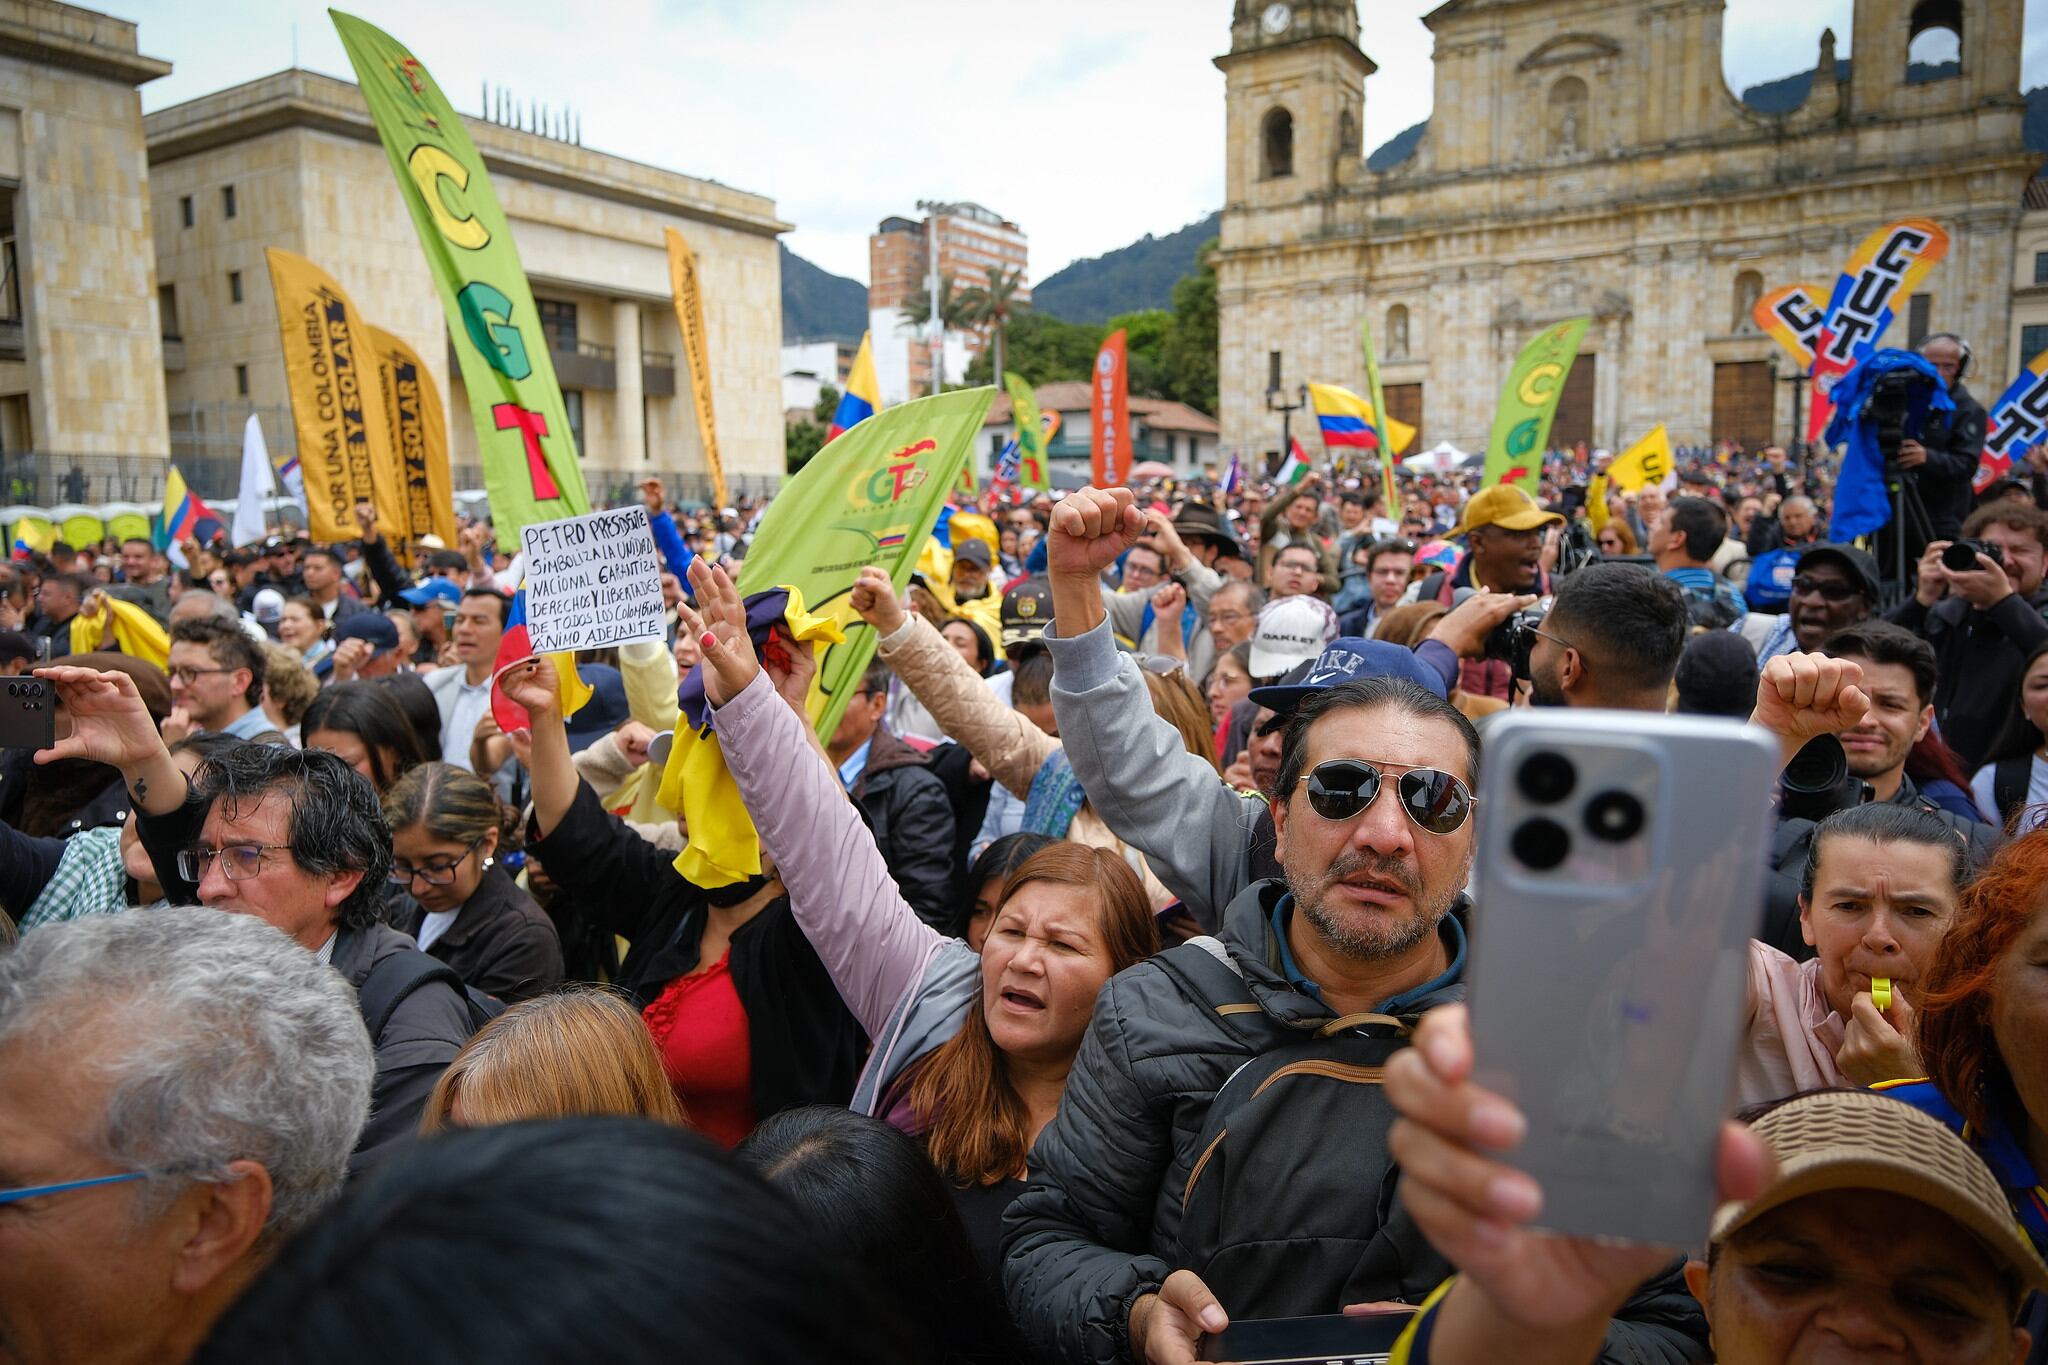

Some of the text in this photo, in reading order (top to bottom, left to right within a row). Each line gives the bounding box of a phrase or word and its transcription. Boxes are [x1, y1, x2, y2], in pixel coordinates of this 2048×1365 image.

[1830, 231, 1926, 359] CUT
[409, 144, 560, 501] CGT
[304, 301, 350, 528] POR UNA COLOMBIA
[329, 319, 373, 498] IBRE Y SOLAR
[398, 378, 433, 534] IBRE Y SOLAR
[847, 463, 915, 510] CGT
[525, 510, 647, 555] PETRO PRESIDENTE
[603, 544, 616, 560] LA
[617, 537, 652, 559] UNIDAD
[531, 578, 660, 618] DERECHOS Y LIBERTADES
[532, 559, 656, 598] NACIONAL GARANTIZA
[529, 619, 548, 636] DE
[553, 612, 592, 629] TODOS
[596, 609, 613, 624] LOS
[585, 620, 658, 645] ADELANTE
